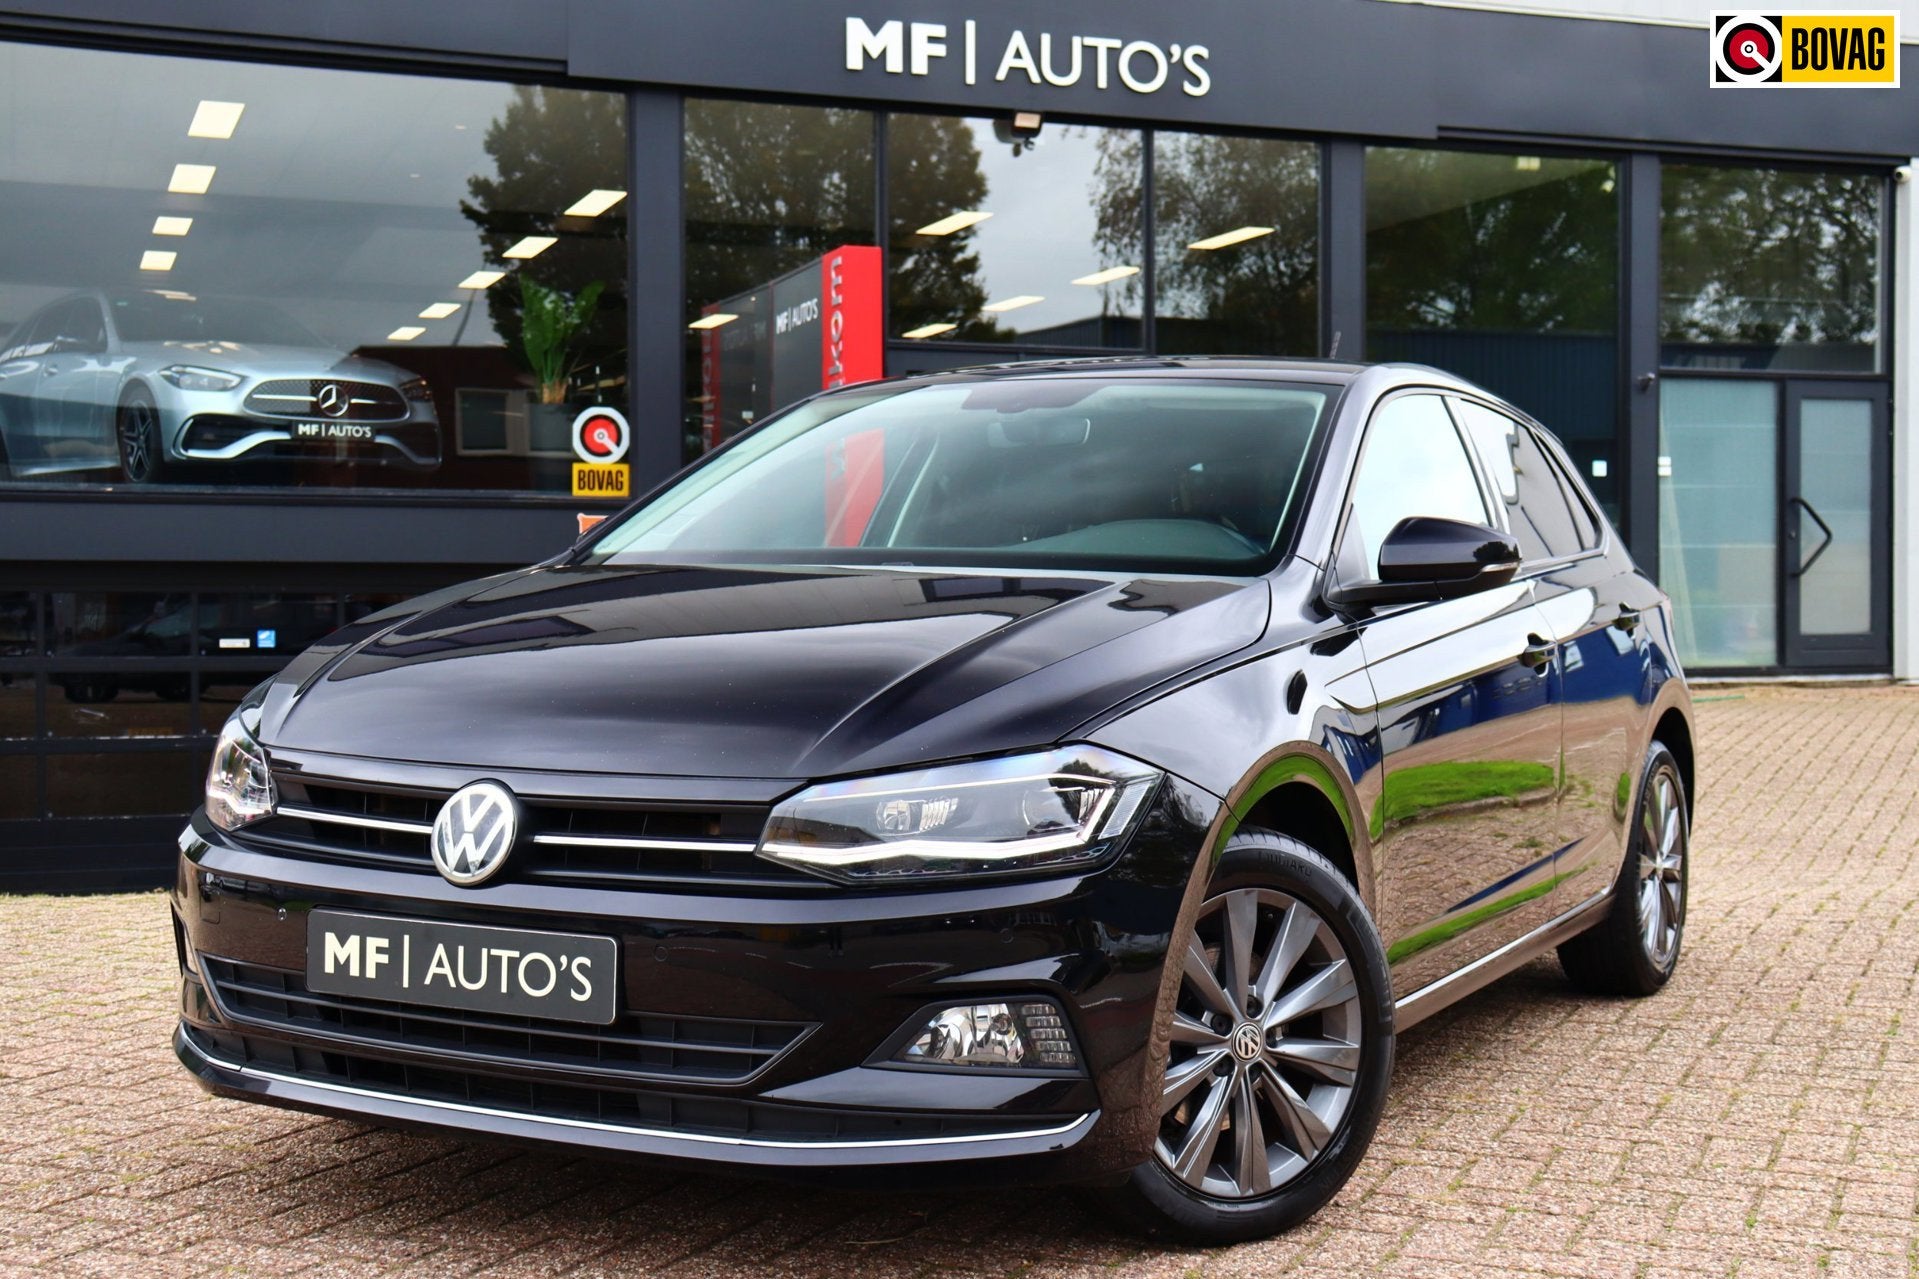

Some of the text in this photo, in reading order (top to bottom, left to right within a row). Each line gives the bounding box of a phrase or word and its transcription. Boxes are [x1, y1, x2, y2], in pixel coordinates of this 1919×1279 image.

[846, 17, 1211, 97] MF AUTO'S
[298, 422, 373, 438] MF AUTO'S
[577, 469, 624, 492] BOVAG
[324, 931, 593, 1002] MF AUTO'S
